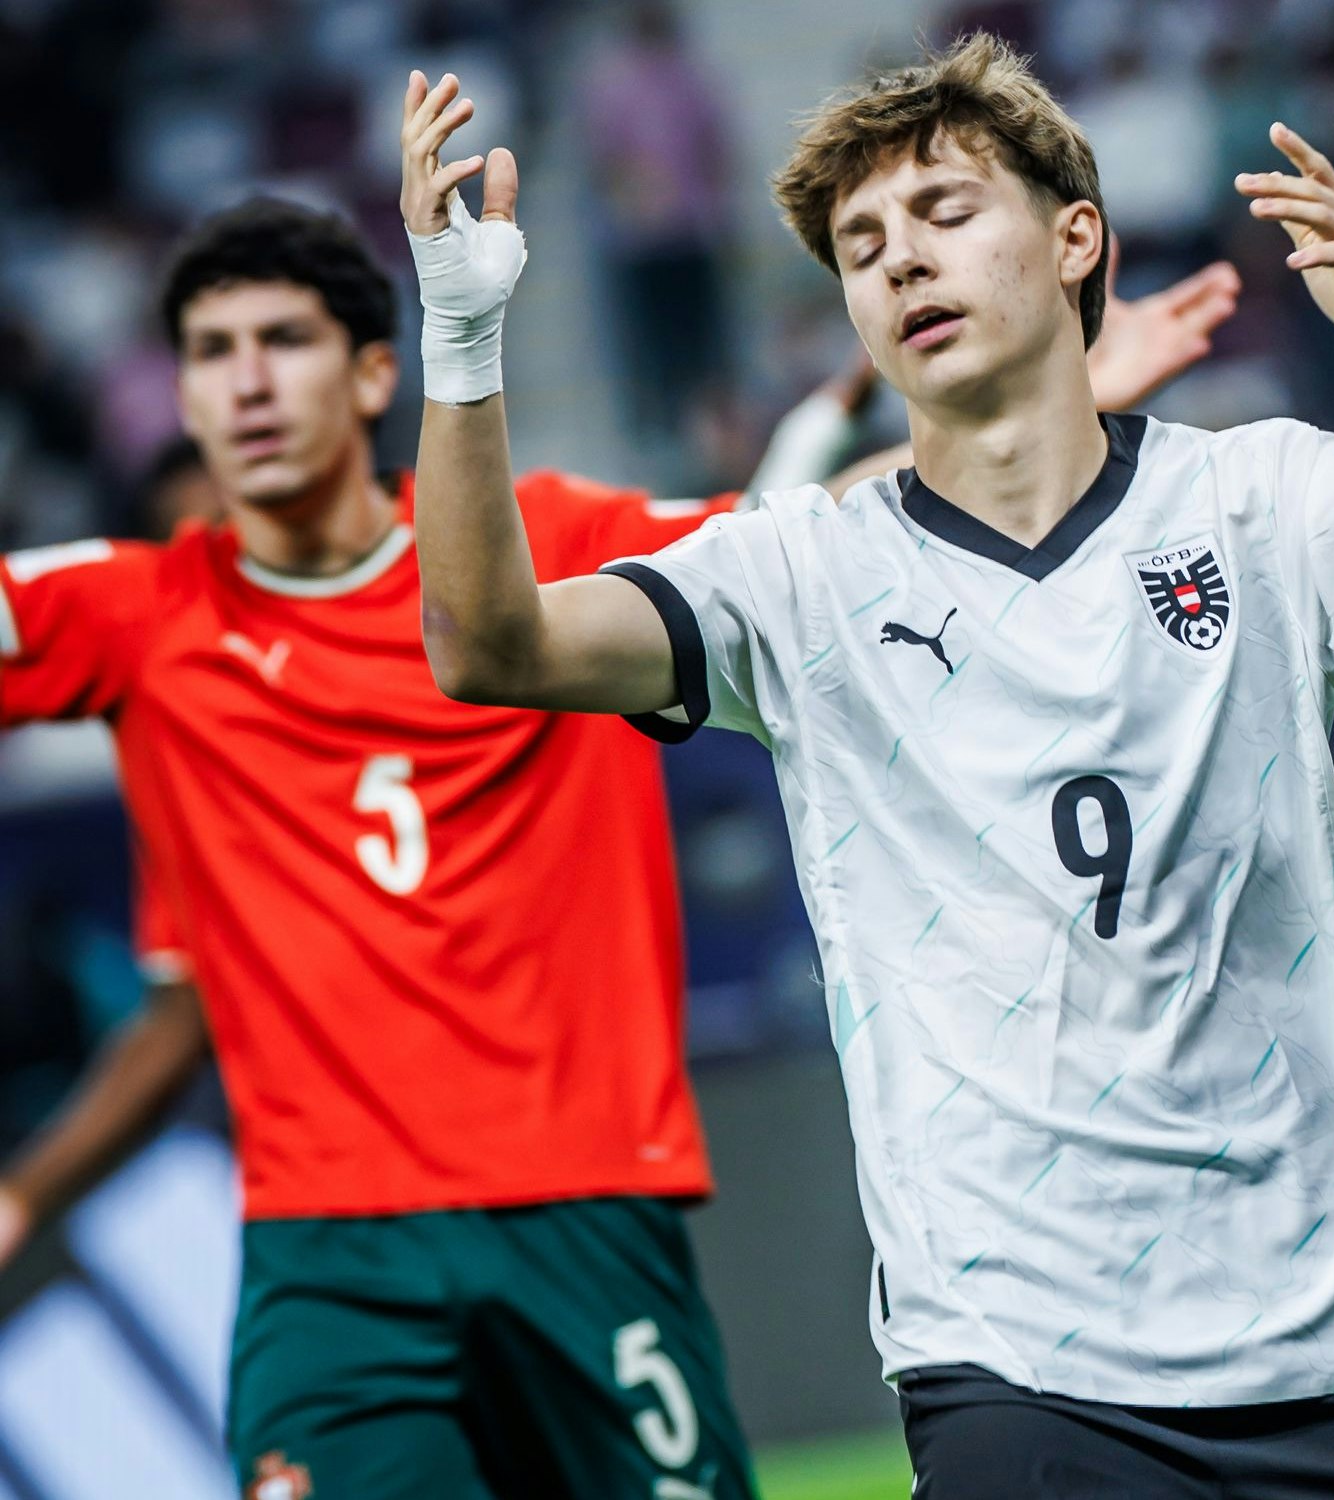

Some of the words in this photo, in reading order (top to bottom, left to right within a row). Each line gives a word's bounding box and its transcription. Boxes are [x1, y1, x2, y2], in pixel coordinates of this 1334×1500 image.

[1151, 548, 1191, 567] ÖFB
[354, 755, 428, 895] 5
[1052, 775, 1133, 939] 9
[613, 1318, 699, 1469] 5
